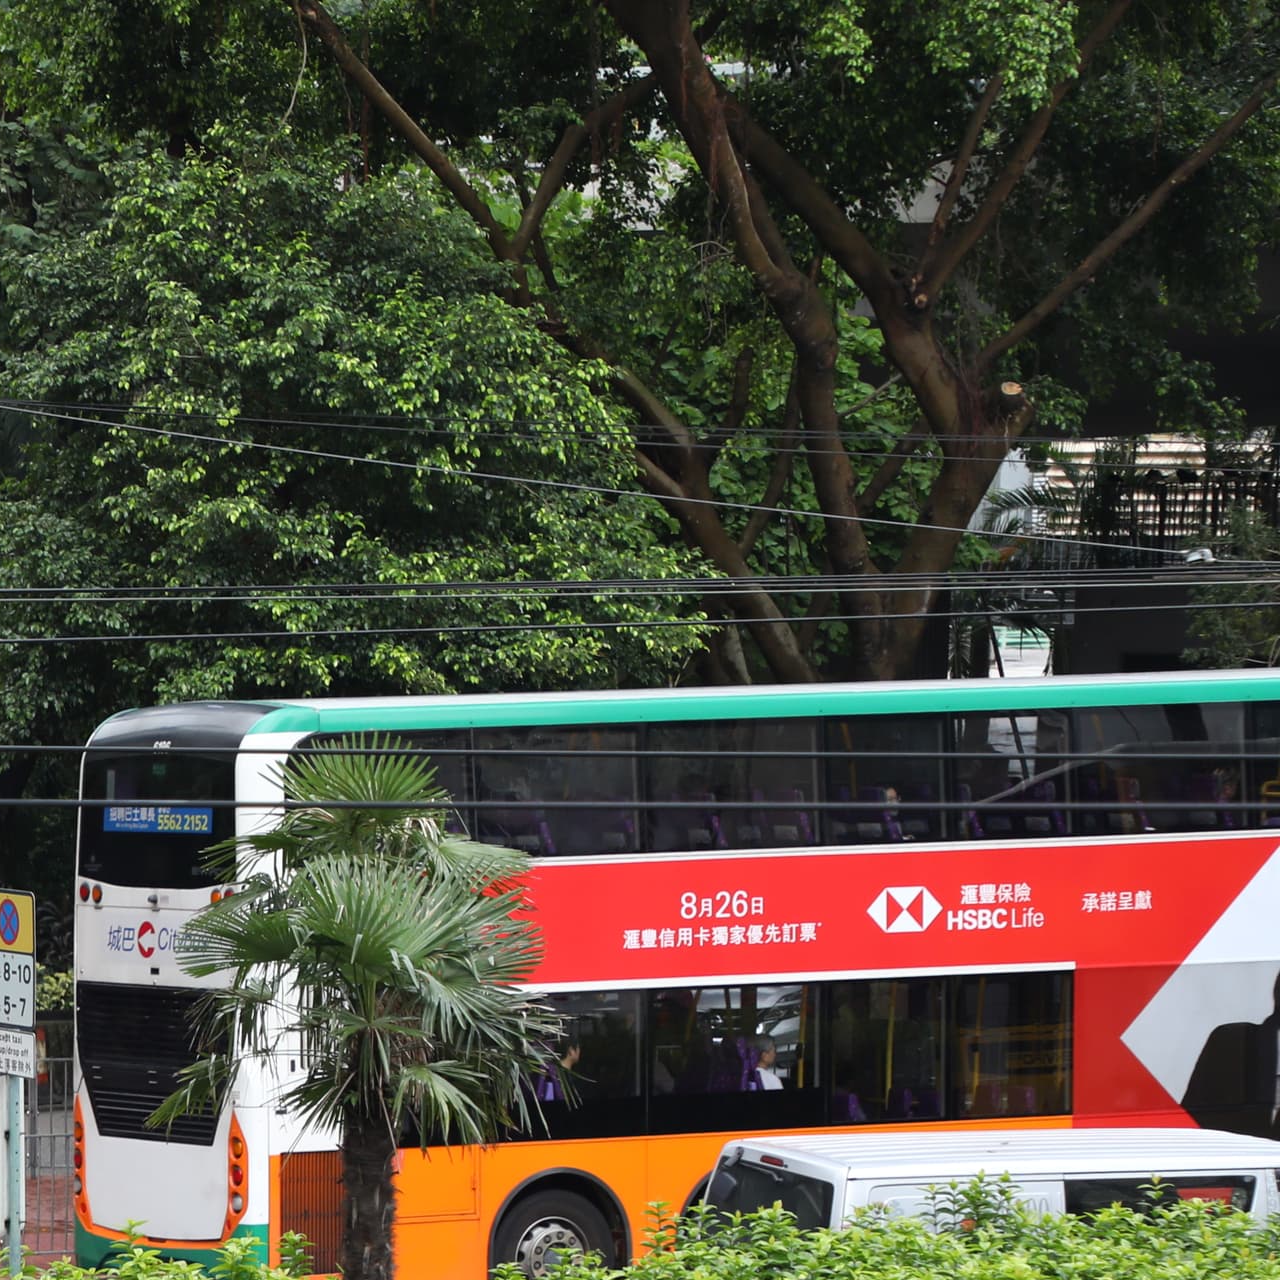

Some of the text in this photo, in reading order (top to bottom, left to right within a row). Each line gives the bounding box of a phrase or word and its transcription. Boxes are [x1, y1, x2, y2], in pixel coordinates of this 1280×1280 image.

[157, 814, 181, 830] 5562
[183, 815, 208, 831] 2152
[680, 890, 764, 919] 8月26日
[946, 907, 1045, 931] HSBC Life
[107, 925, 135, 951] 城巴
[3, 962, 31, 984] 8-10
[12, 1034, 23, 1044] taxi
[21, 1048, 29, 1056] off
